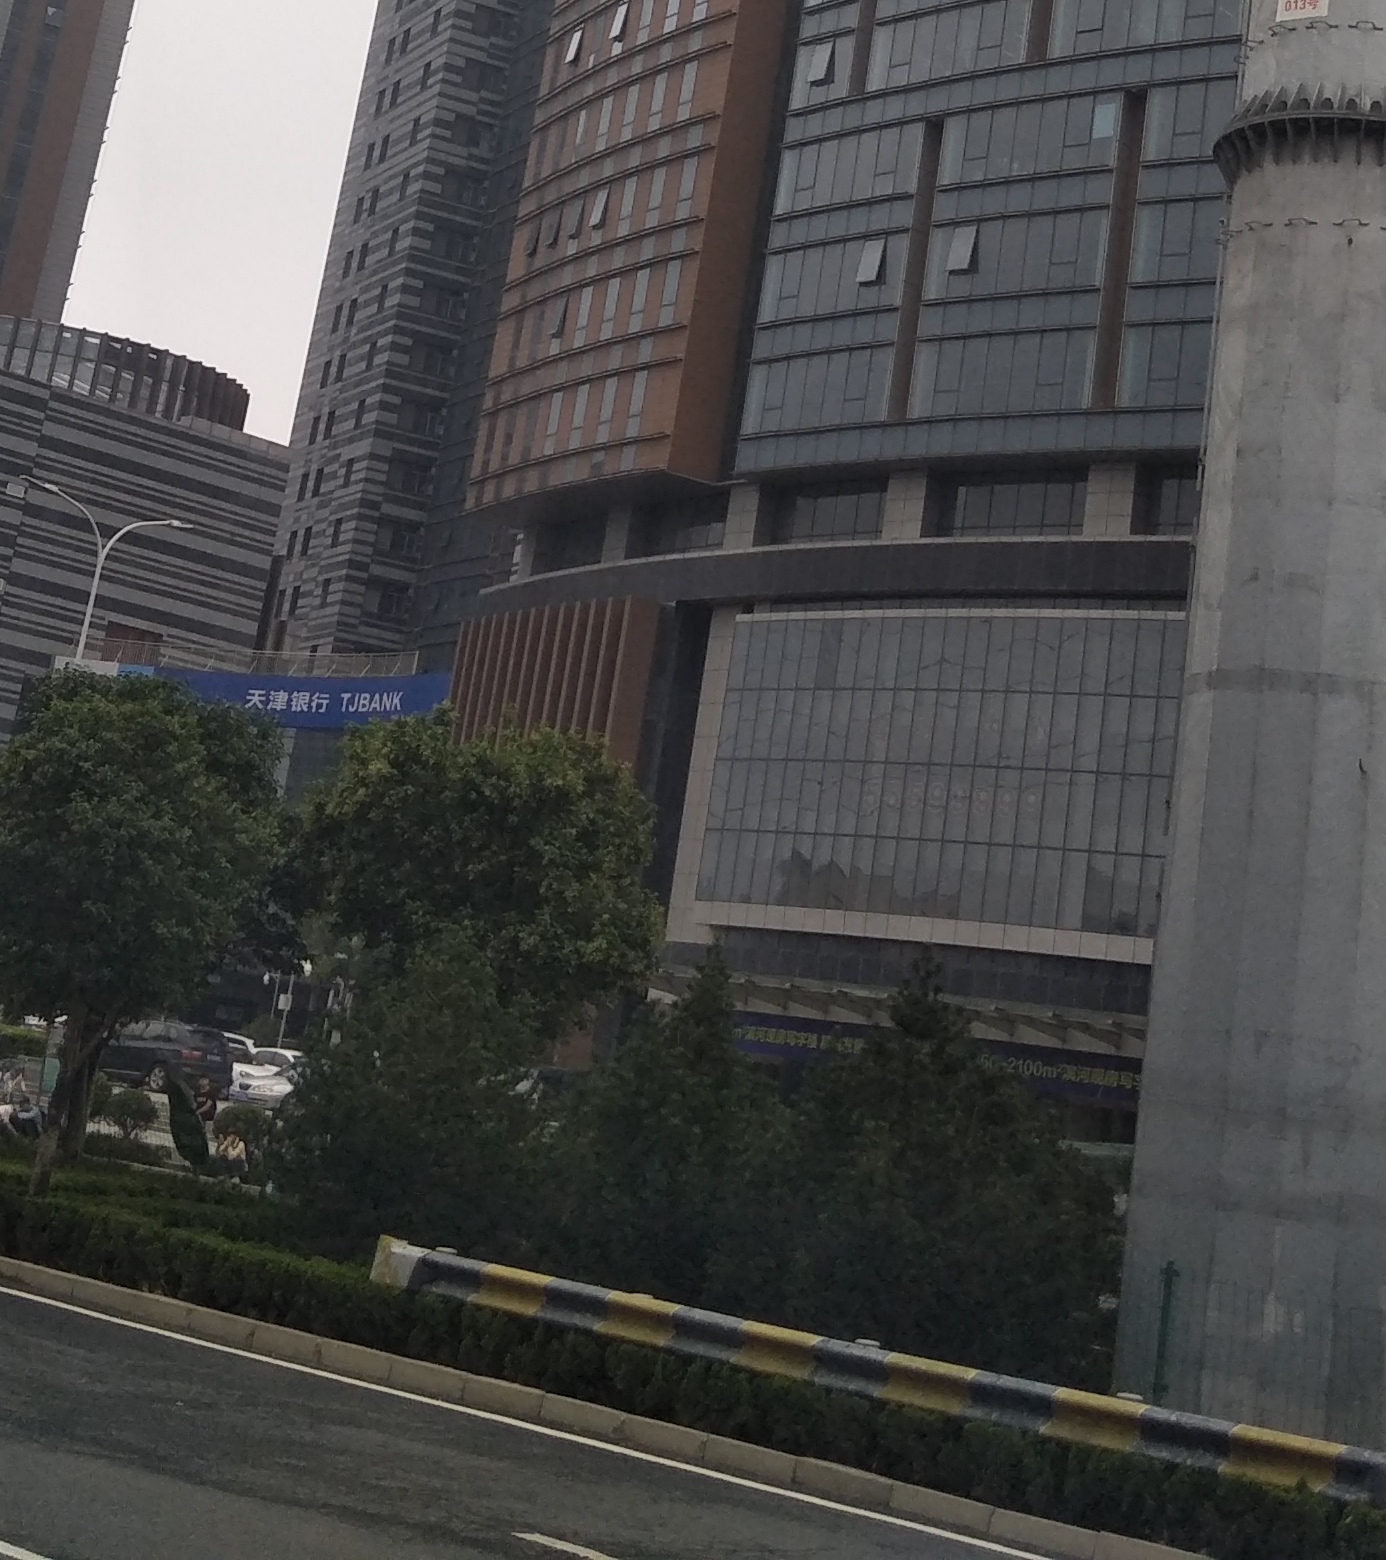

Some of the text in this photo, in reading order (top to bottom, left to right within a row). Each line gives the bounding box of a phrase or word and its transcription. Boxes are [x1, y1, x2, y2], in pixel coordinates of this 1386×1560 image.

[245, 689, 404, 713] 天津银行 TJBANK
